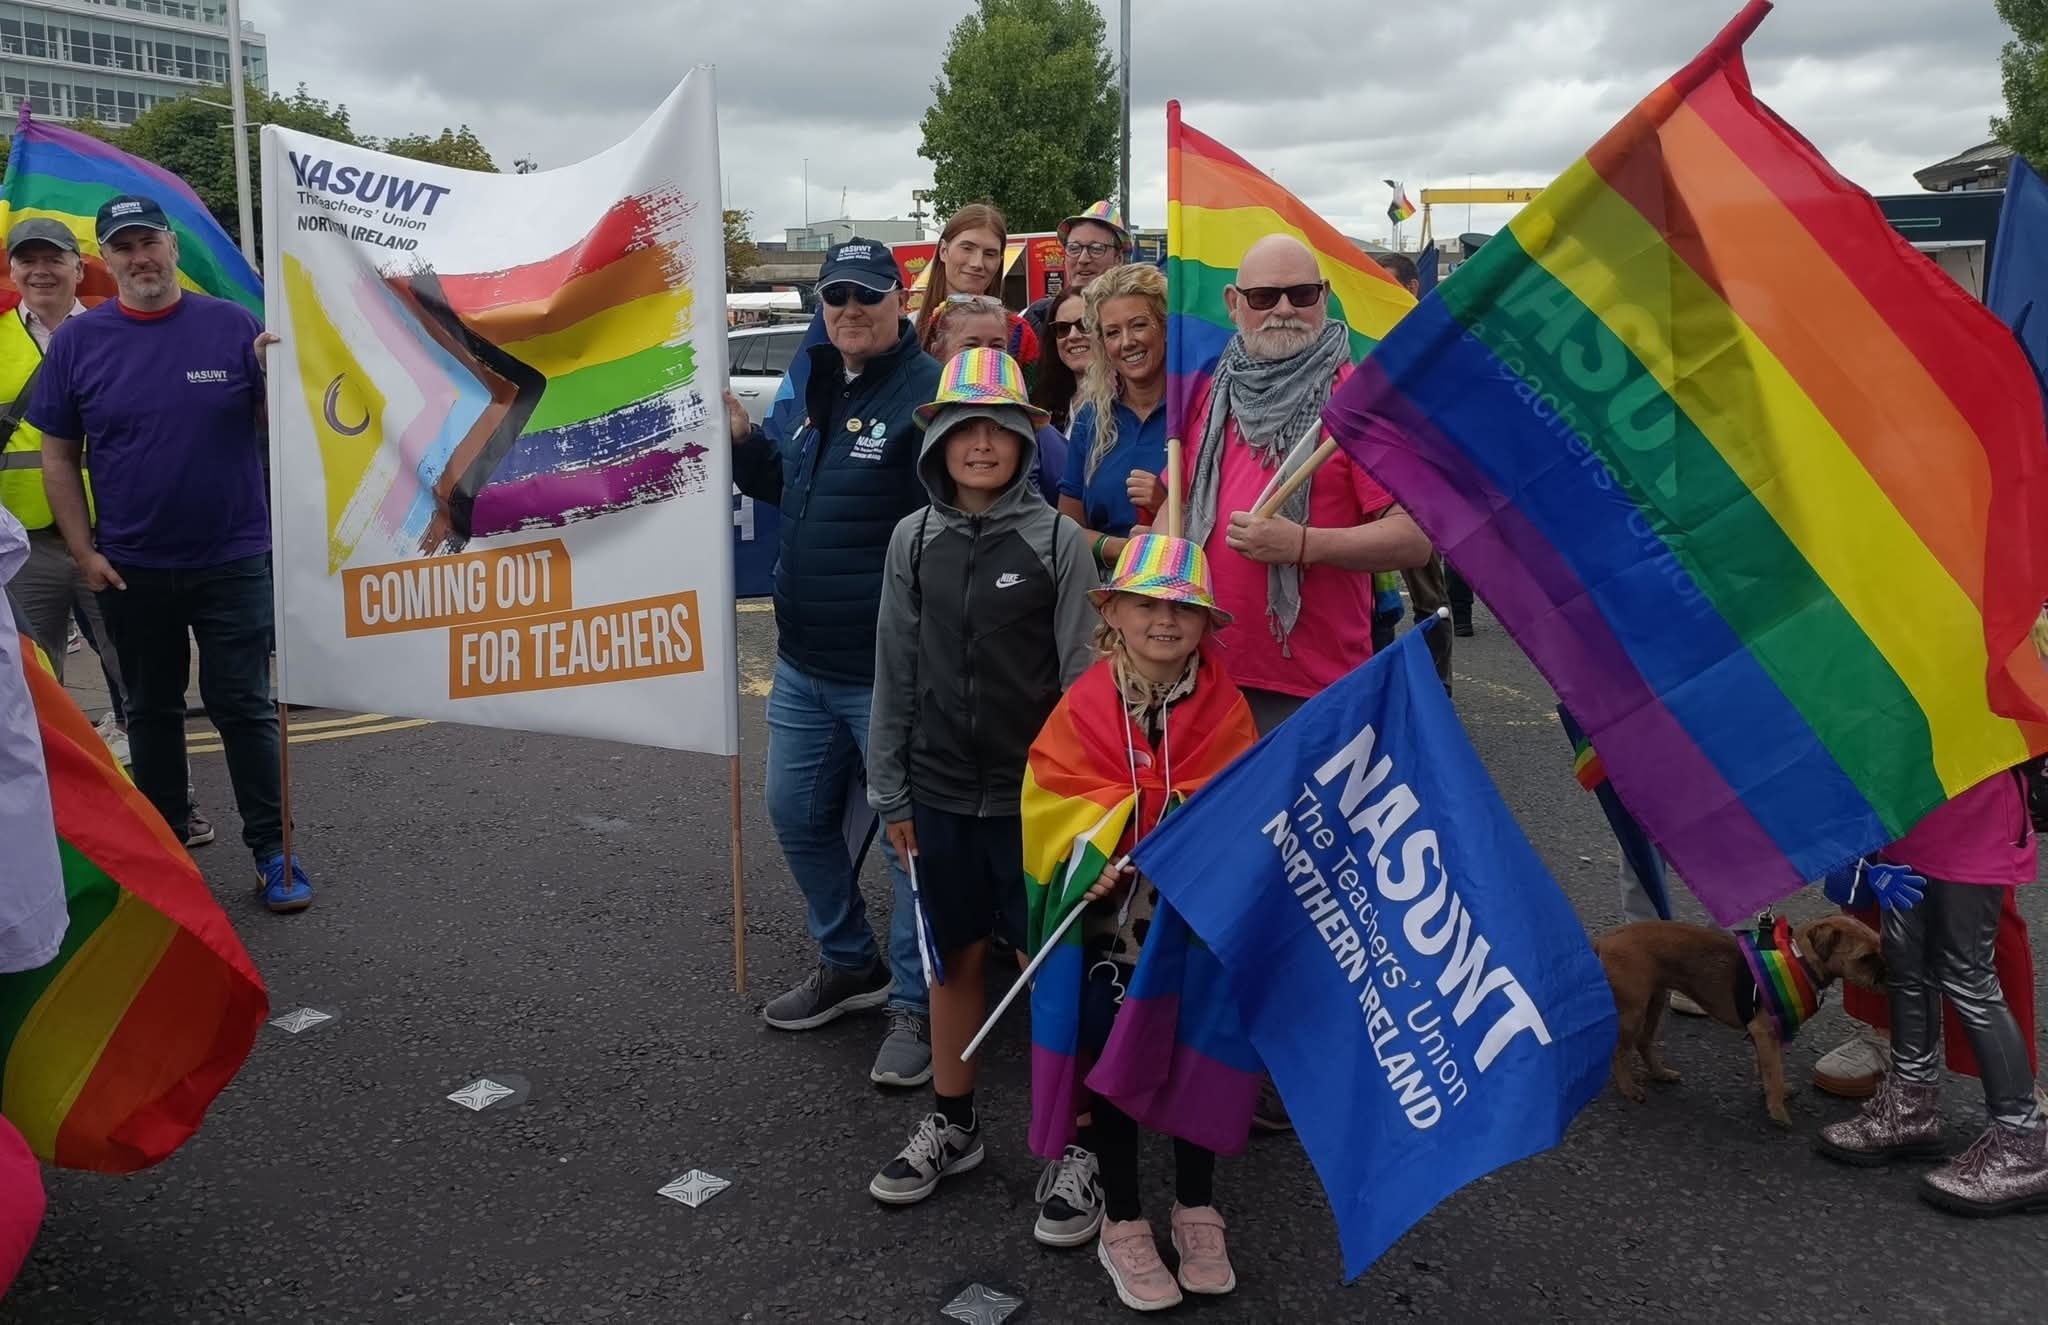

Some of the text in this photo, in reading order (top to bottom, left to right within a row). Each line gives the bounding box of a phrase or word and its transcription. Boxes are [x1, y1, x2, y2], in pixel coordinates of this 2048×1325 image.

[288, 151, 451, 216] NASUWT
[1507, 191, 1515, 200] H
[351, 225, 418, 251] IRELAND
[382, 212, 427, 231] Union
[840, 245, 872, 254] NASUWT
[186, 369, 227, 380] NASUWT
[359, 550, 552, 626] COMING OUT
[1001, 572, 1020, 583] NIKE
[461, 603, 693, 687] FOR TEACHERS
[1313, 723, 1552, 1073] NASUWT
[1293, 782, 1471, 1107] The Teachers' Union
[1261, 810, 1443, 1129] NORTHERN IRELAND
